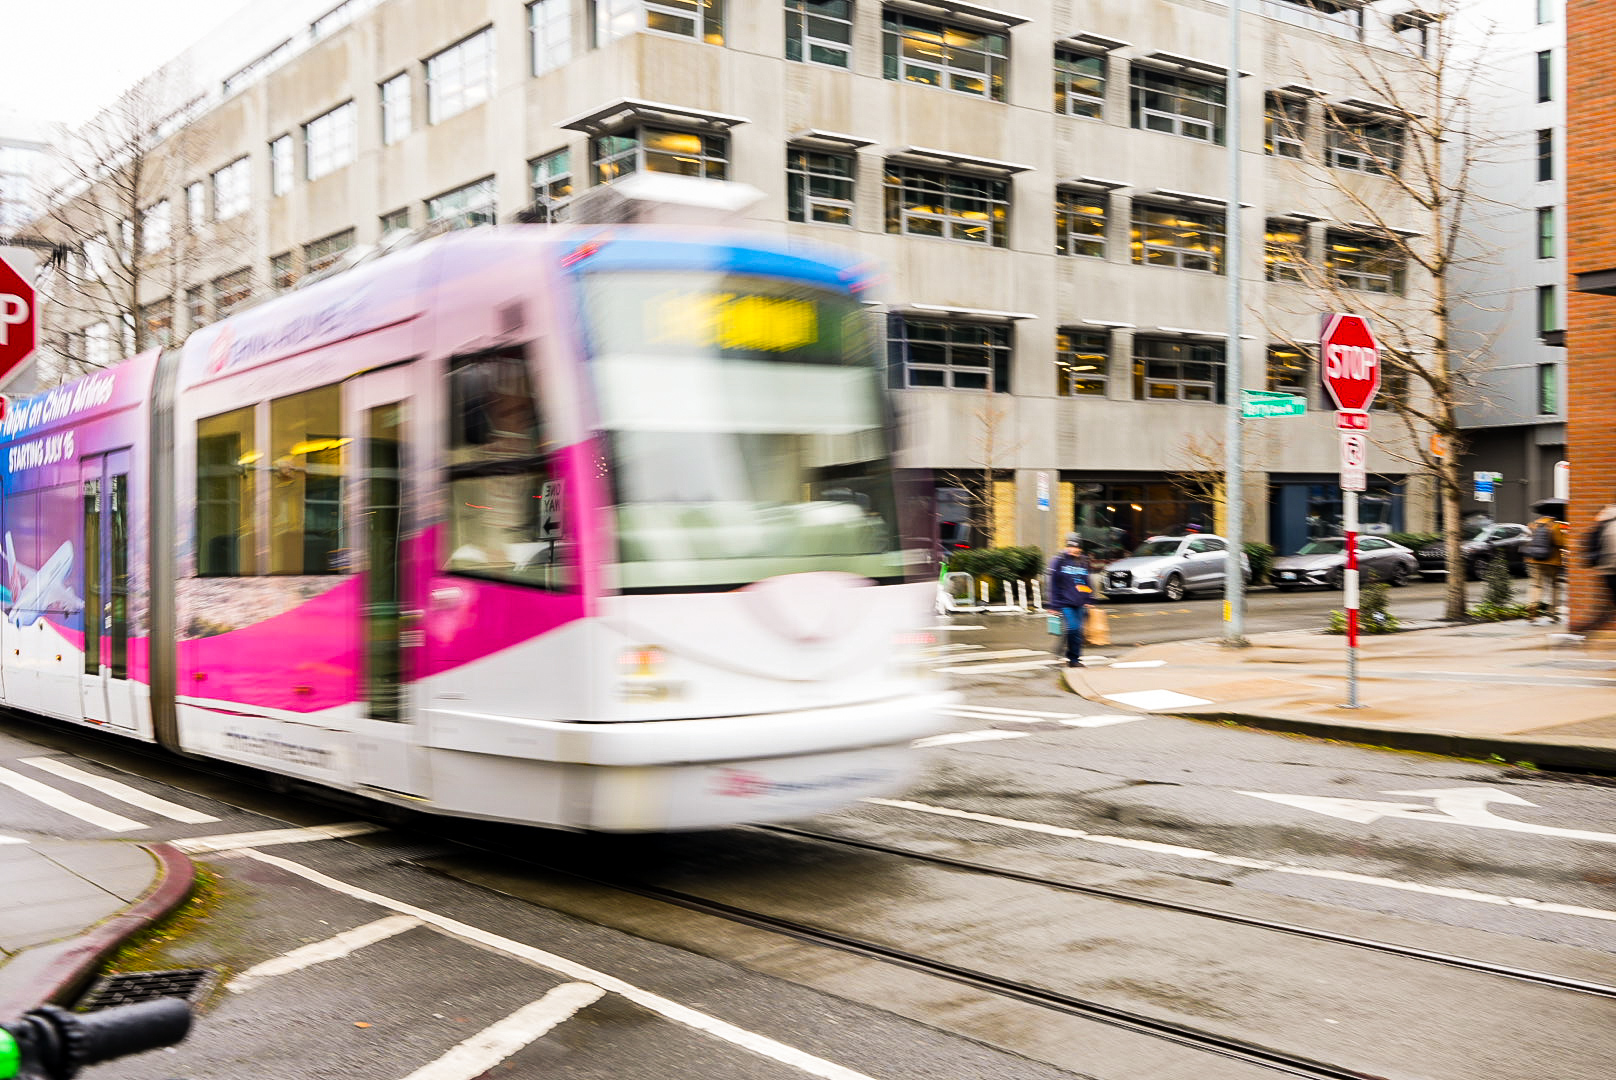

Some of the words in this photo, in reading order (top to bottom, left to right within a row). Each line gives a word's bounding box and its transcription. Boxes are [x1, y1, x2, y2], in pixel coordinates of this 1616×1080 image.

[1327, 343, 1376, 381] STOP
[3, 398, 32, 440] Taipei
[29, 401, 43, 430] on
[42, 385, 73, 424] China
[70, 373, 116, 414] Airlines
[9, 439, 44, 473] STARTING
[44, 433, 63, 465] JULY
